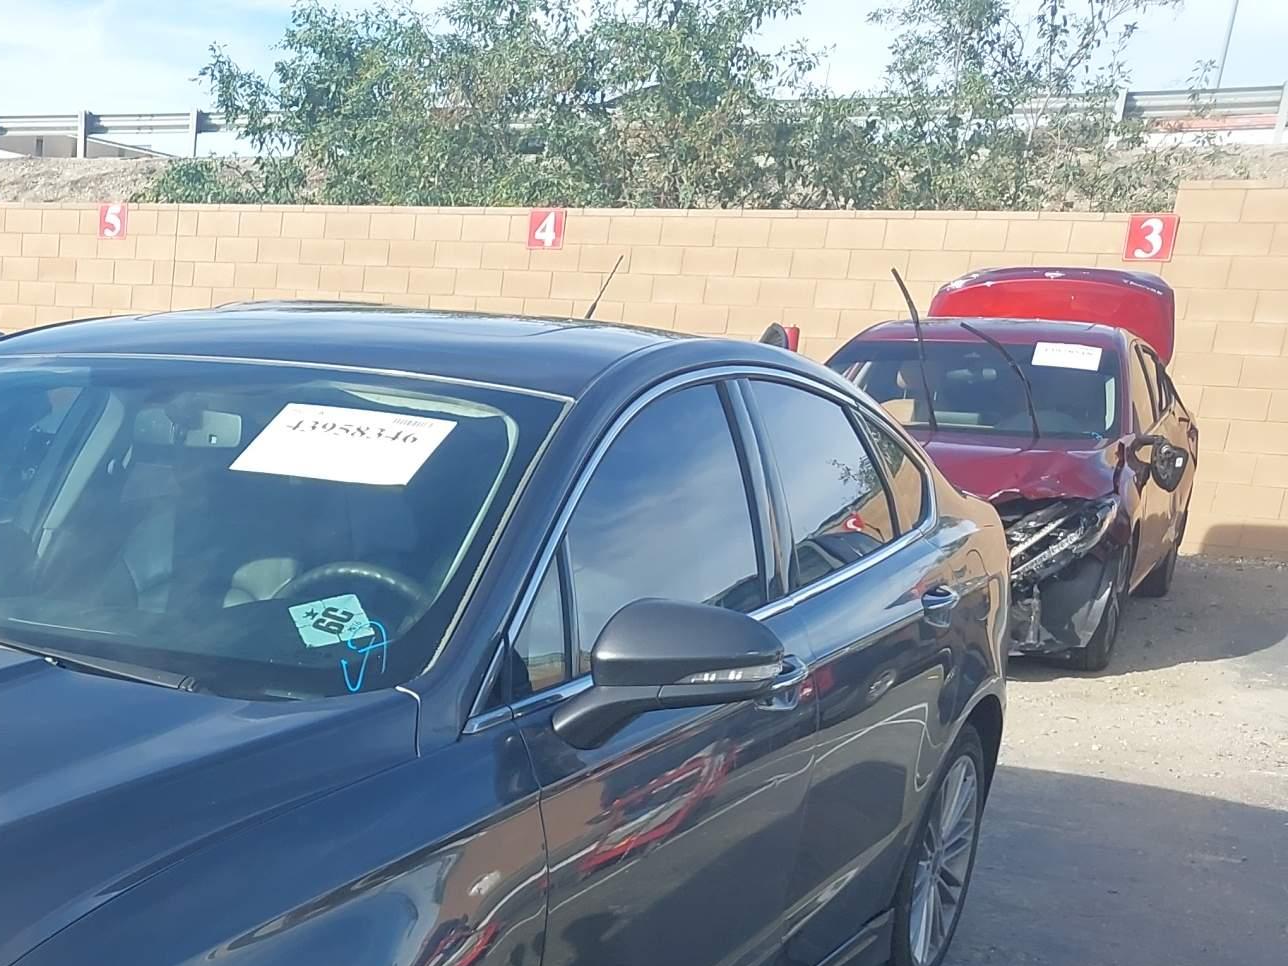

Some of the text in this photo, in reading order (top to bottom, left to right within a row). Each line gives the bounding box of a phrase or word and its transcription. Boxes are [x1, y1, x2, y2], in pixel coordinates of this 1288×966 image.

[103, 204, 121, 237] 5
[534, 210, 556, 247] 4
[1133, 217, 1164, 259] 3
[285, 418, 419, 444] 43958346
